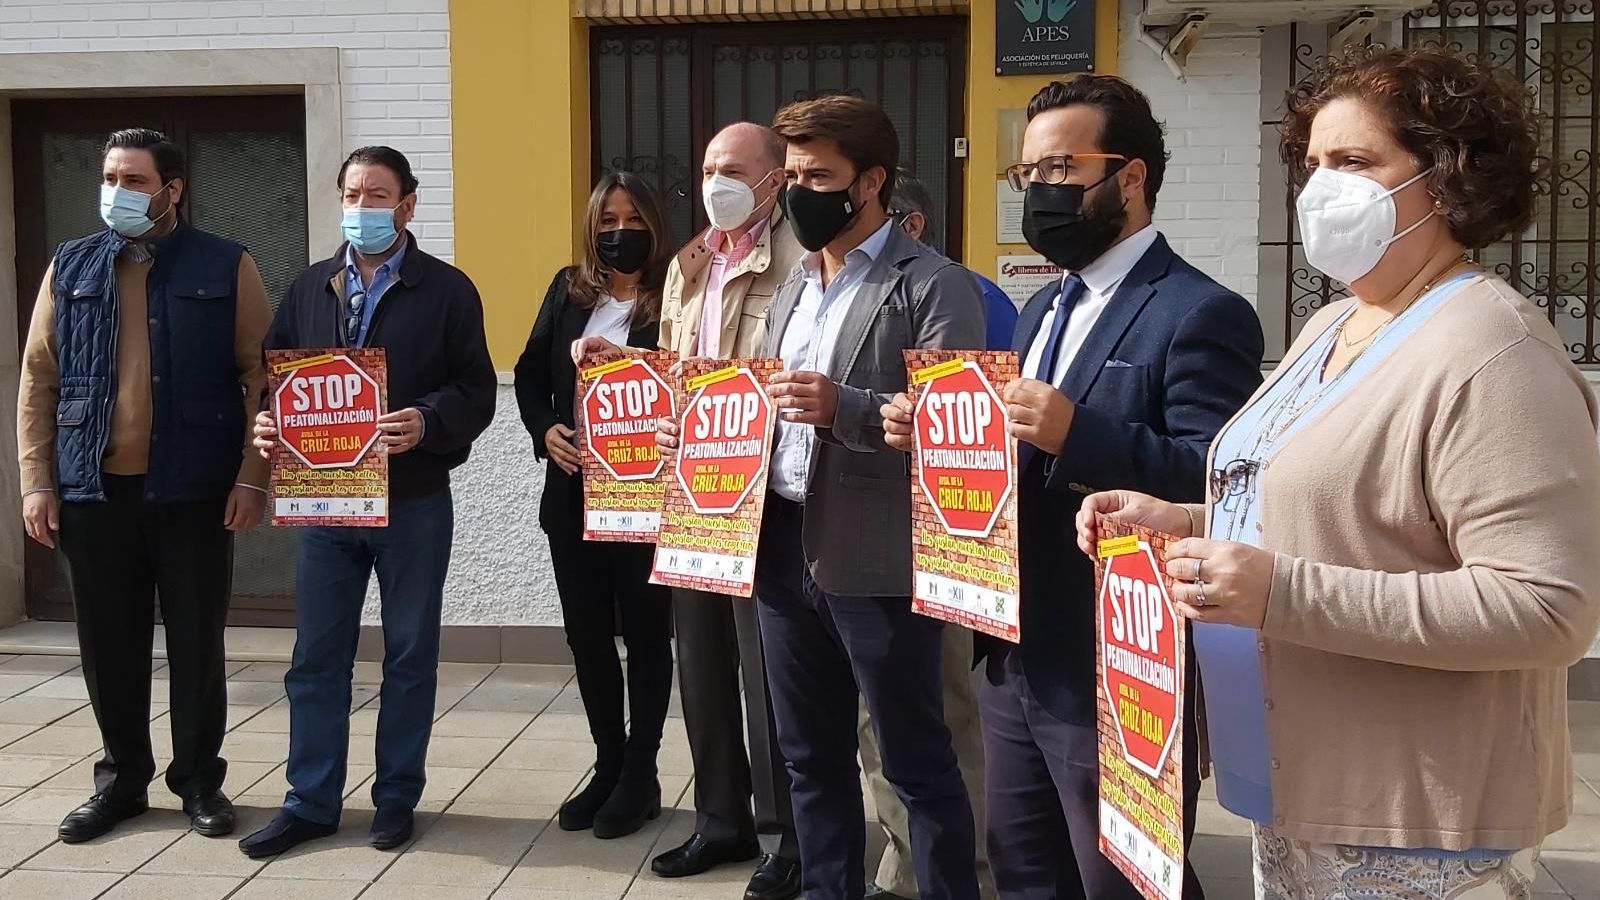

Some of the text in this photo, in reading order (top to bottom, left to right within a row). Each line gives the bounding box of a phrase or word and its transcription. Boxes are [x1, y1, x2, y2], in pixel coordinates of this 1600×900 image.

[1022, 26, 1070, 42] APES
[1002, 54, 1040, 62] ASOCIACIÓN
[1051, 52, 1089, 61] PELUQUERÍA
[1018, 266, 1038, 274] libros
[1040, 266, 1049, 274] de
[1050, 266, 1057, 274] la
[291, 373, 362, 412] STOP
[596, 379, 659, 420] STOP
[284, 406, 374, 428] PEATONALIZACIÓN
[695, 392, 759, 440] STOP
[926, 391, 992, 445] STOP
[592, 419, 658, 436] PEATONALIZACI
[301, 436, 362, 453] CRUZ ROJA
[607, 446, 661, 464] CRUZ ROJA
[684, 435, 762, 459] PEATONALIZACIÓN
[713, 464, 719, 472] LA
[922, 444, 1005, 470] PEATONALIZACIÓN
[692, 473, 745, 493] CRUZ ROJA
[950, 476, 957, 486] DE
[957, 477, 963, 486] LA
[938, 488, 993, 513] CRUZ ROJA
[1108, 572, 1163, 655] STOP
[1106, 643, 1175, 695] PEATONALIZACIÓN
[1129, 687, 1135, 701] DE
[1134, 689, 1140, 703] LA
[1119, 697, 1164, 747] CRUZ ROJA
